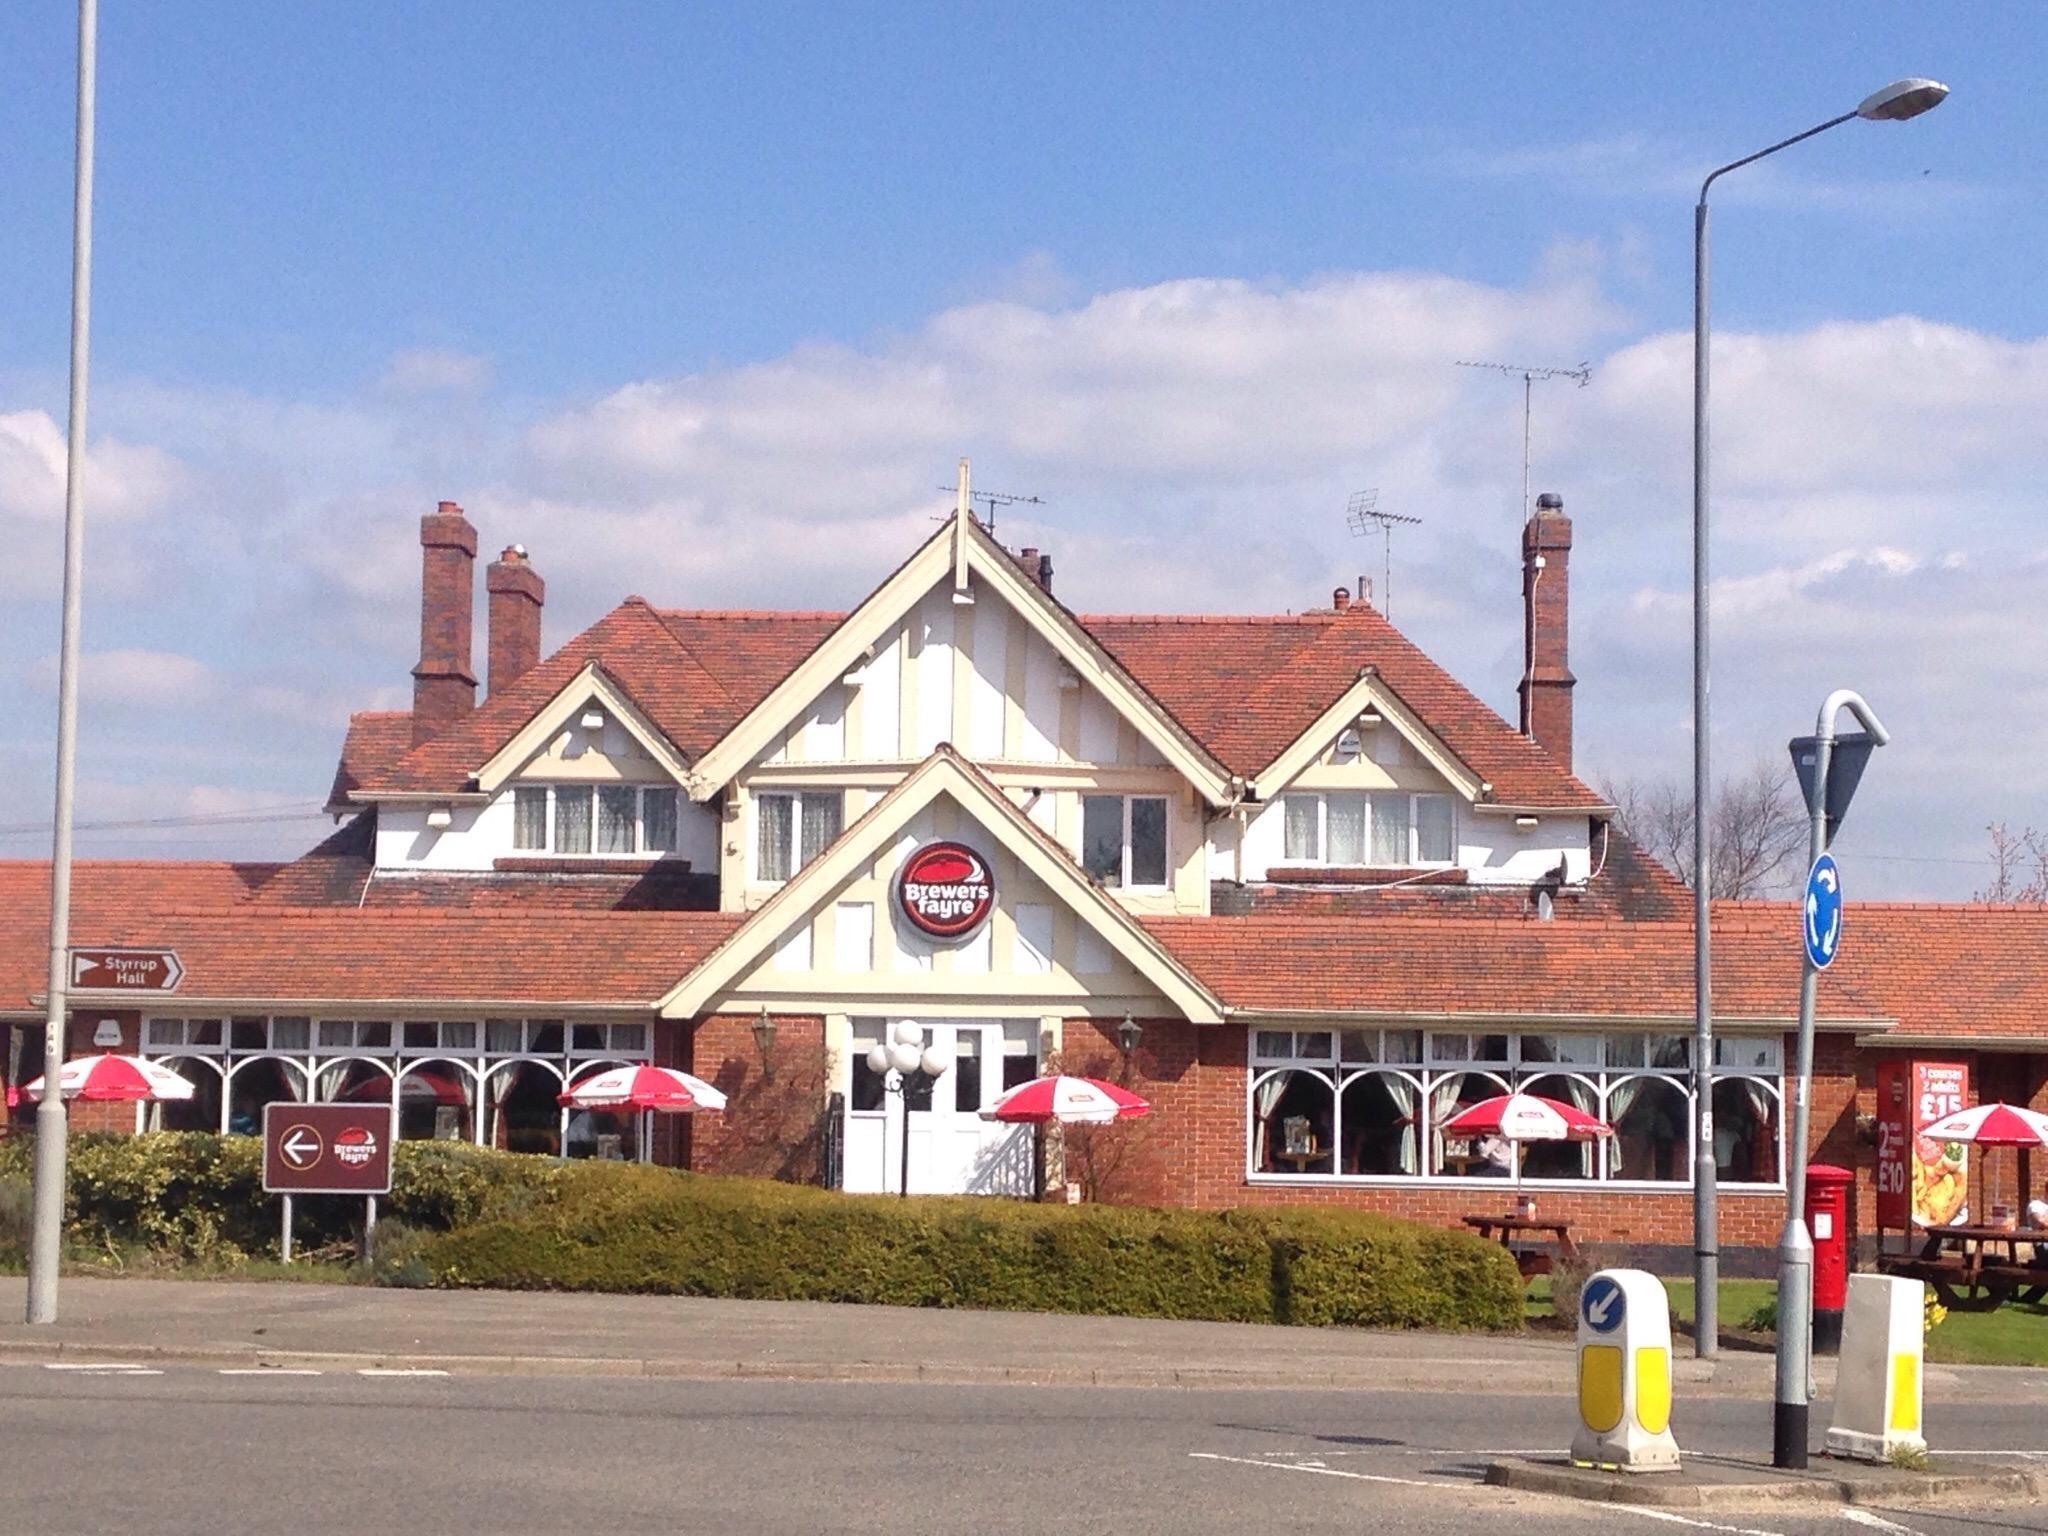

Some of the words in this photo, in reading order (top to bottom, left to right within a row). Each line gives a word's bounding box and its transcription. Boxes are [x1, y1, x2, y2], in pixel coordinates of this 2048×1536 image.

[905, 883, 989, 900] Brewers
[917, 895, 975, 919] fayre
[104, 956, 158, 971] Styrrup
[116, 972, 146, 984] Hall
[1920, 1093, 1962, 1121] £15
[1879, 1121, 1889, 1158] 2
[1878, 1160, 1904, 1194] £10
